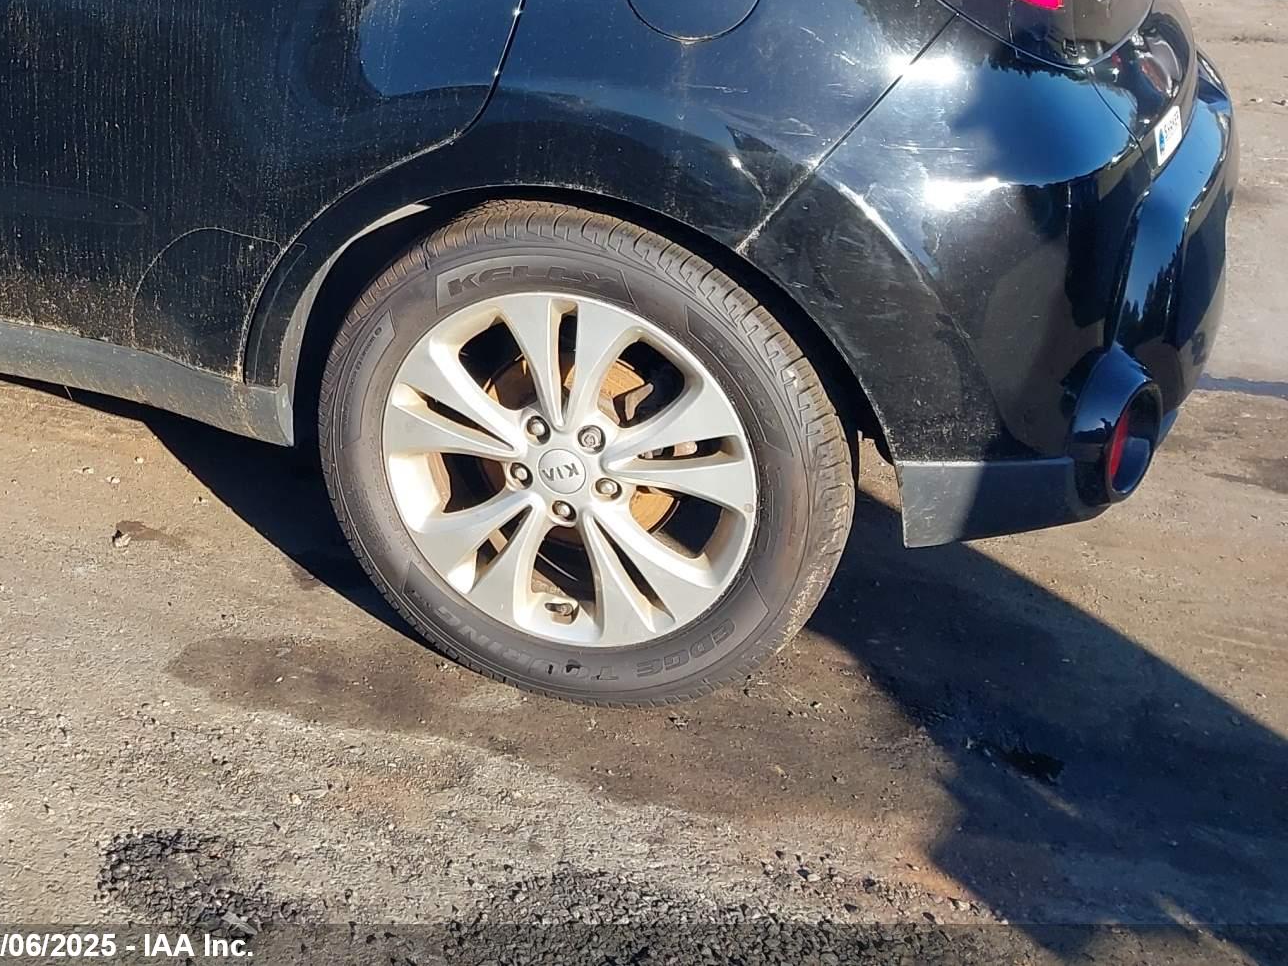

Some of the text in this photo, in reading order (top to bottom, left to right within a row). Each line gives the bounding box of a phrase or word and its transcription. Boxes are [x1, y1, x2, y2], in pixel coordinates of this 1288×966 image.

[446, 264, 618, 298] KELLY
[542, 462, 580, 482] KIA
[436, 605, 736, 681] EDGE TOURING
